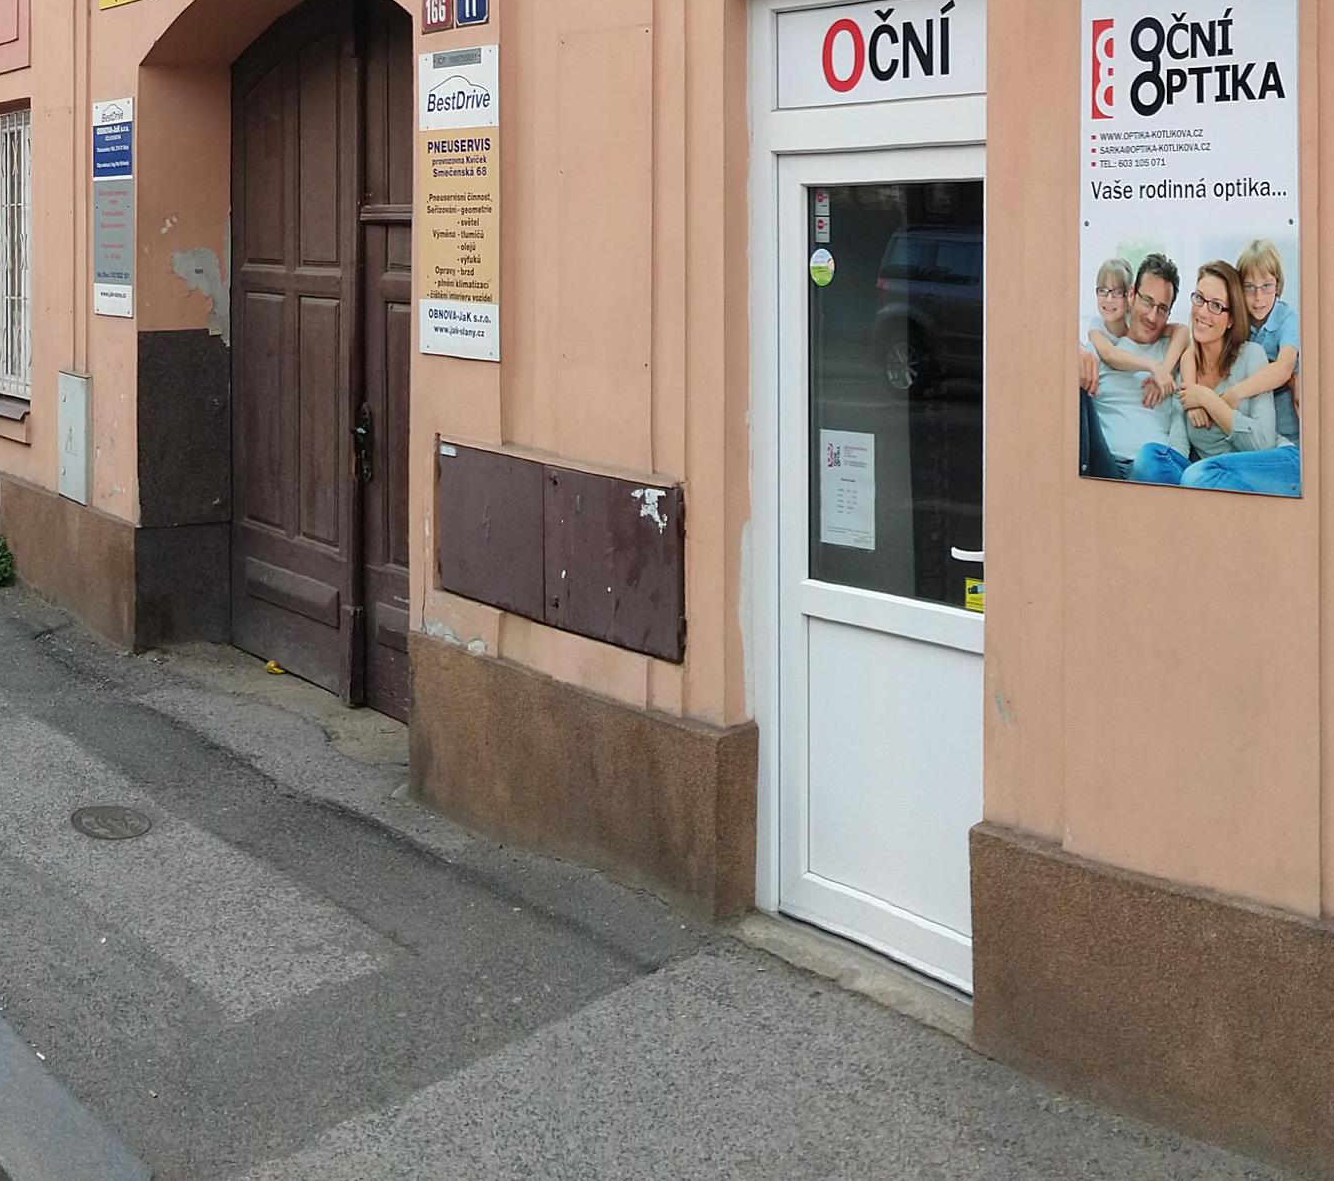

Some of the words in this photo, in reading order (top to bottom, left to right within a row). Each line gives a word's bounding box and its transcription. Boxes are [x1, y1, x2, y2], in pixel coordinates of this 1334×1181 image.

[822, 0, 956, 93] OČNÍ
[1130, 7, 1234, 63] OČNÍ
[1130, 61, 1286, 117] OPTIKA
[427, 90, 491, 113] BestDrive
[427, 137, 491, 154] PNEUSERVIS
[433, 166, 475, 178] Smečenská
[476, 166, 487, 176] 68
[1118, 158, 1133, 168] 603
[1151, 157, 1166, 167] 071
[1091, 180, 1133, 200] Vaše
[1139, 178, 1206, 199] rodinná
[1213, 177, 1287, 201] optika...
[428, 308, 472, 323] OBNOVA-JaK
[473, 314, 492, 324] s.r.o.
